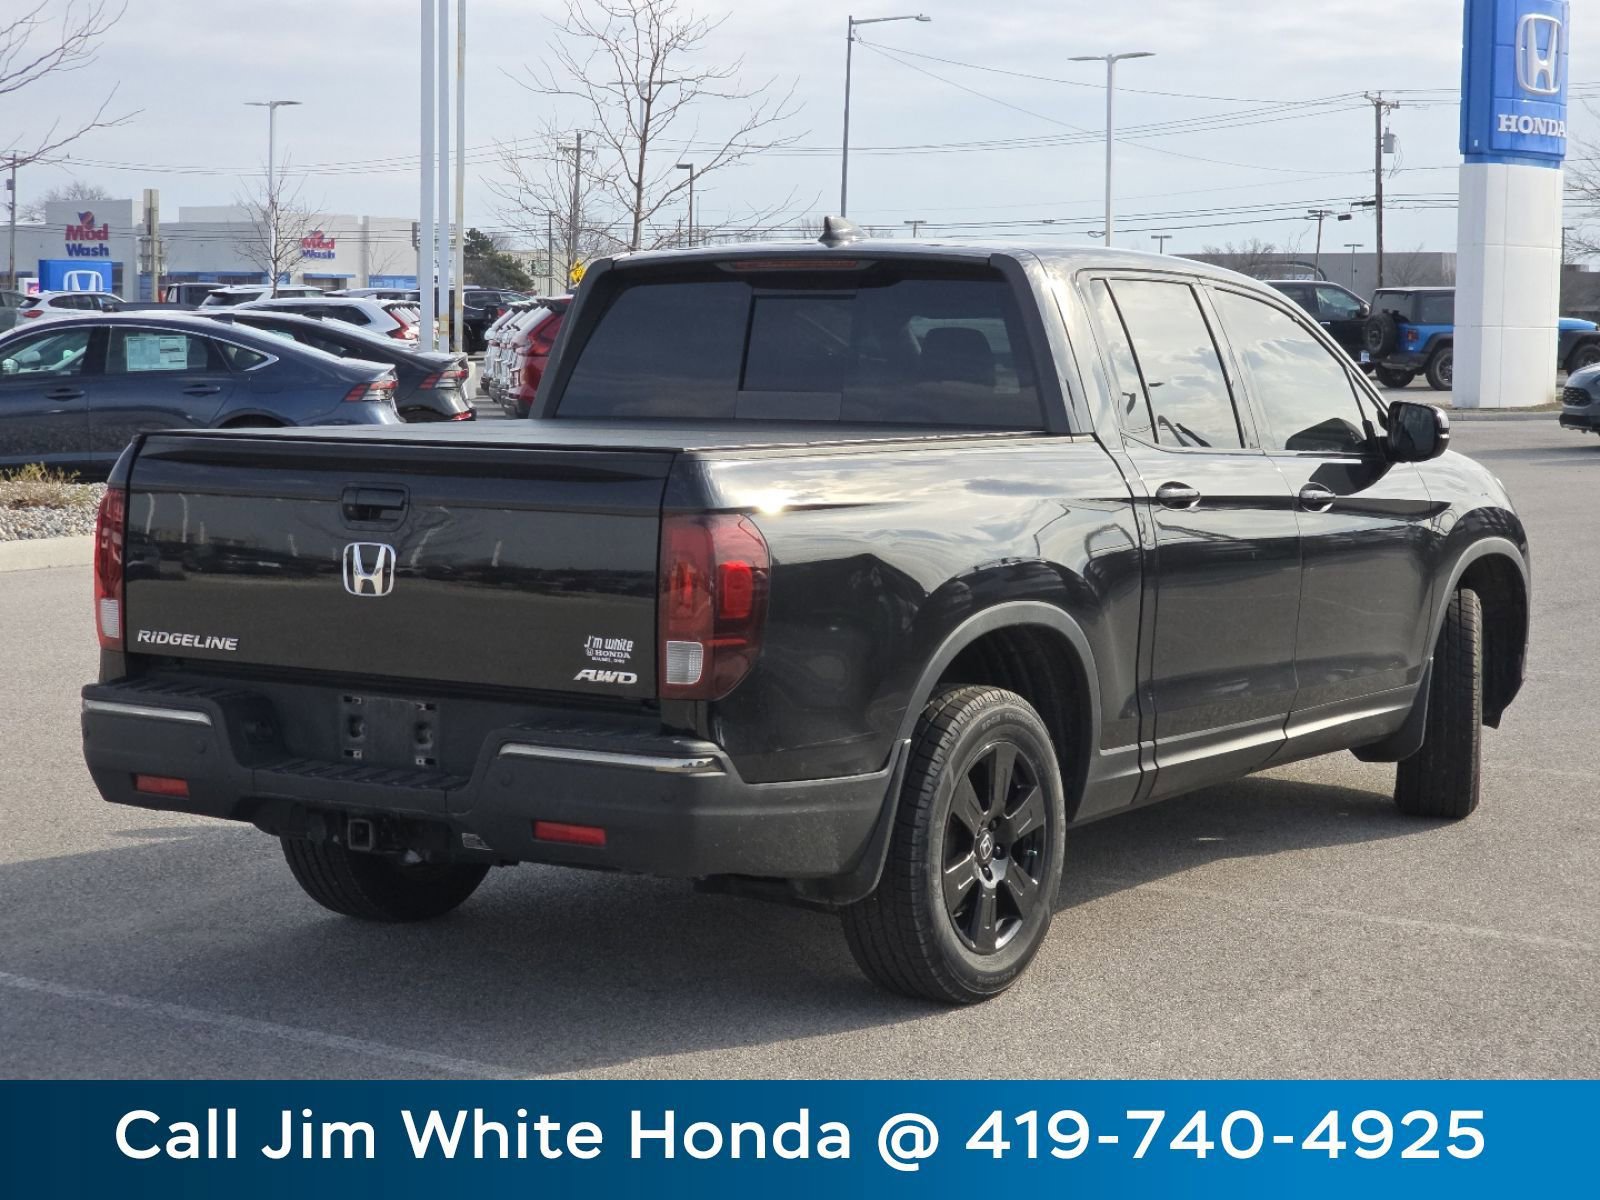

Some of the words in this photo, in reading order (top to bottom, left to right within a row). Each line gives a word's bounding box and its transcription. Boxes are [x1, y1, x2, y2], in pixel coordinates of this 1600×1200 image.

[1498, 113, 1567, 138] HONDA
[65, 223, 109, 241] Mod
[65, 242, 110, 257] Wash
[302, 249, 336, 259] Wash
[137, 629, 239, 651] RIDGELINE
[595, 649, 631, 659] HONDA
[573, 668, 638, 684] AWD
